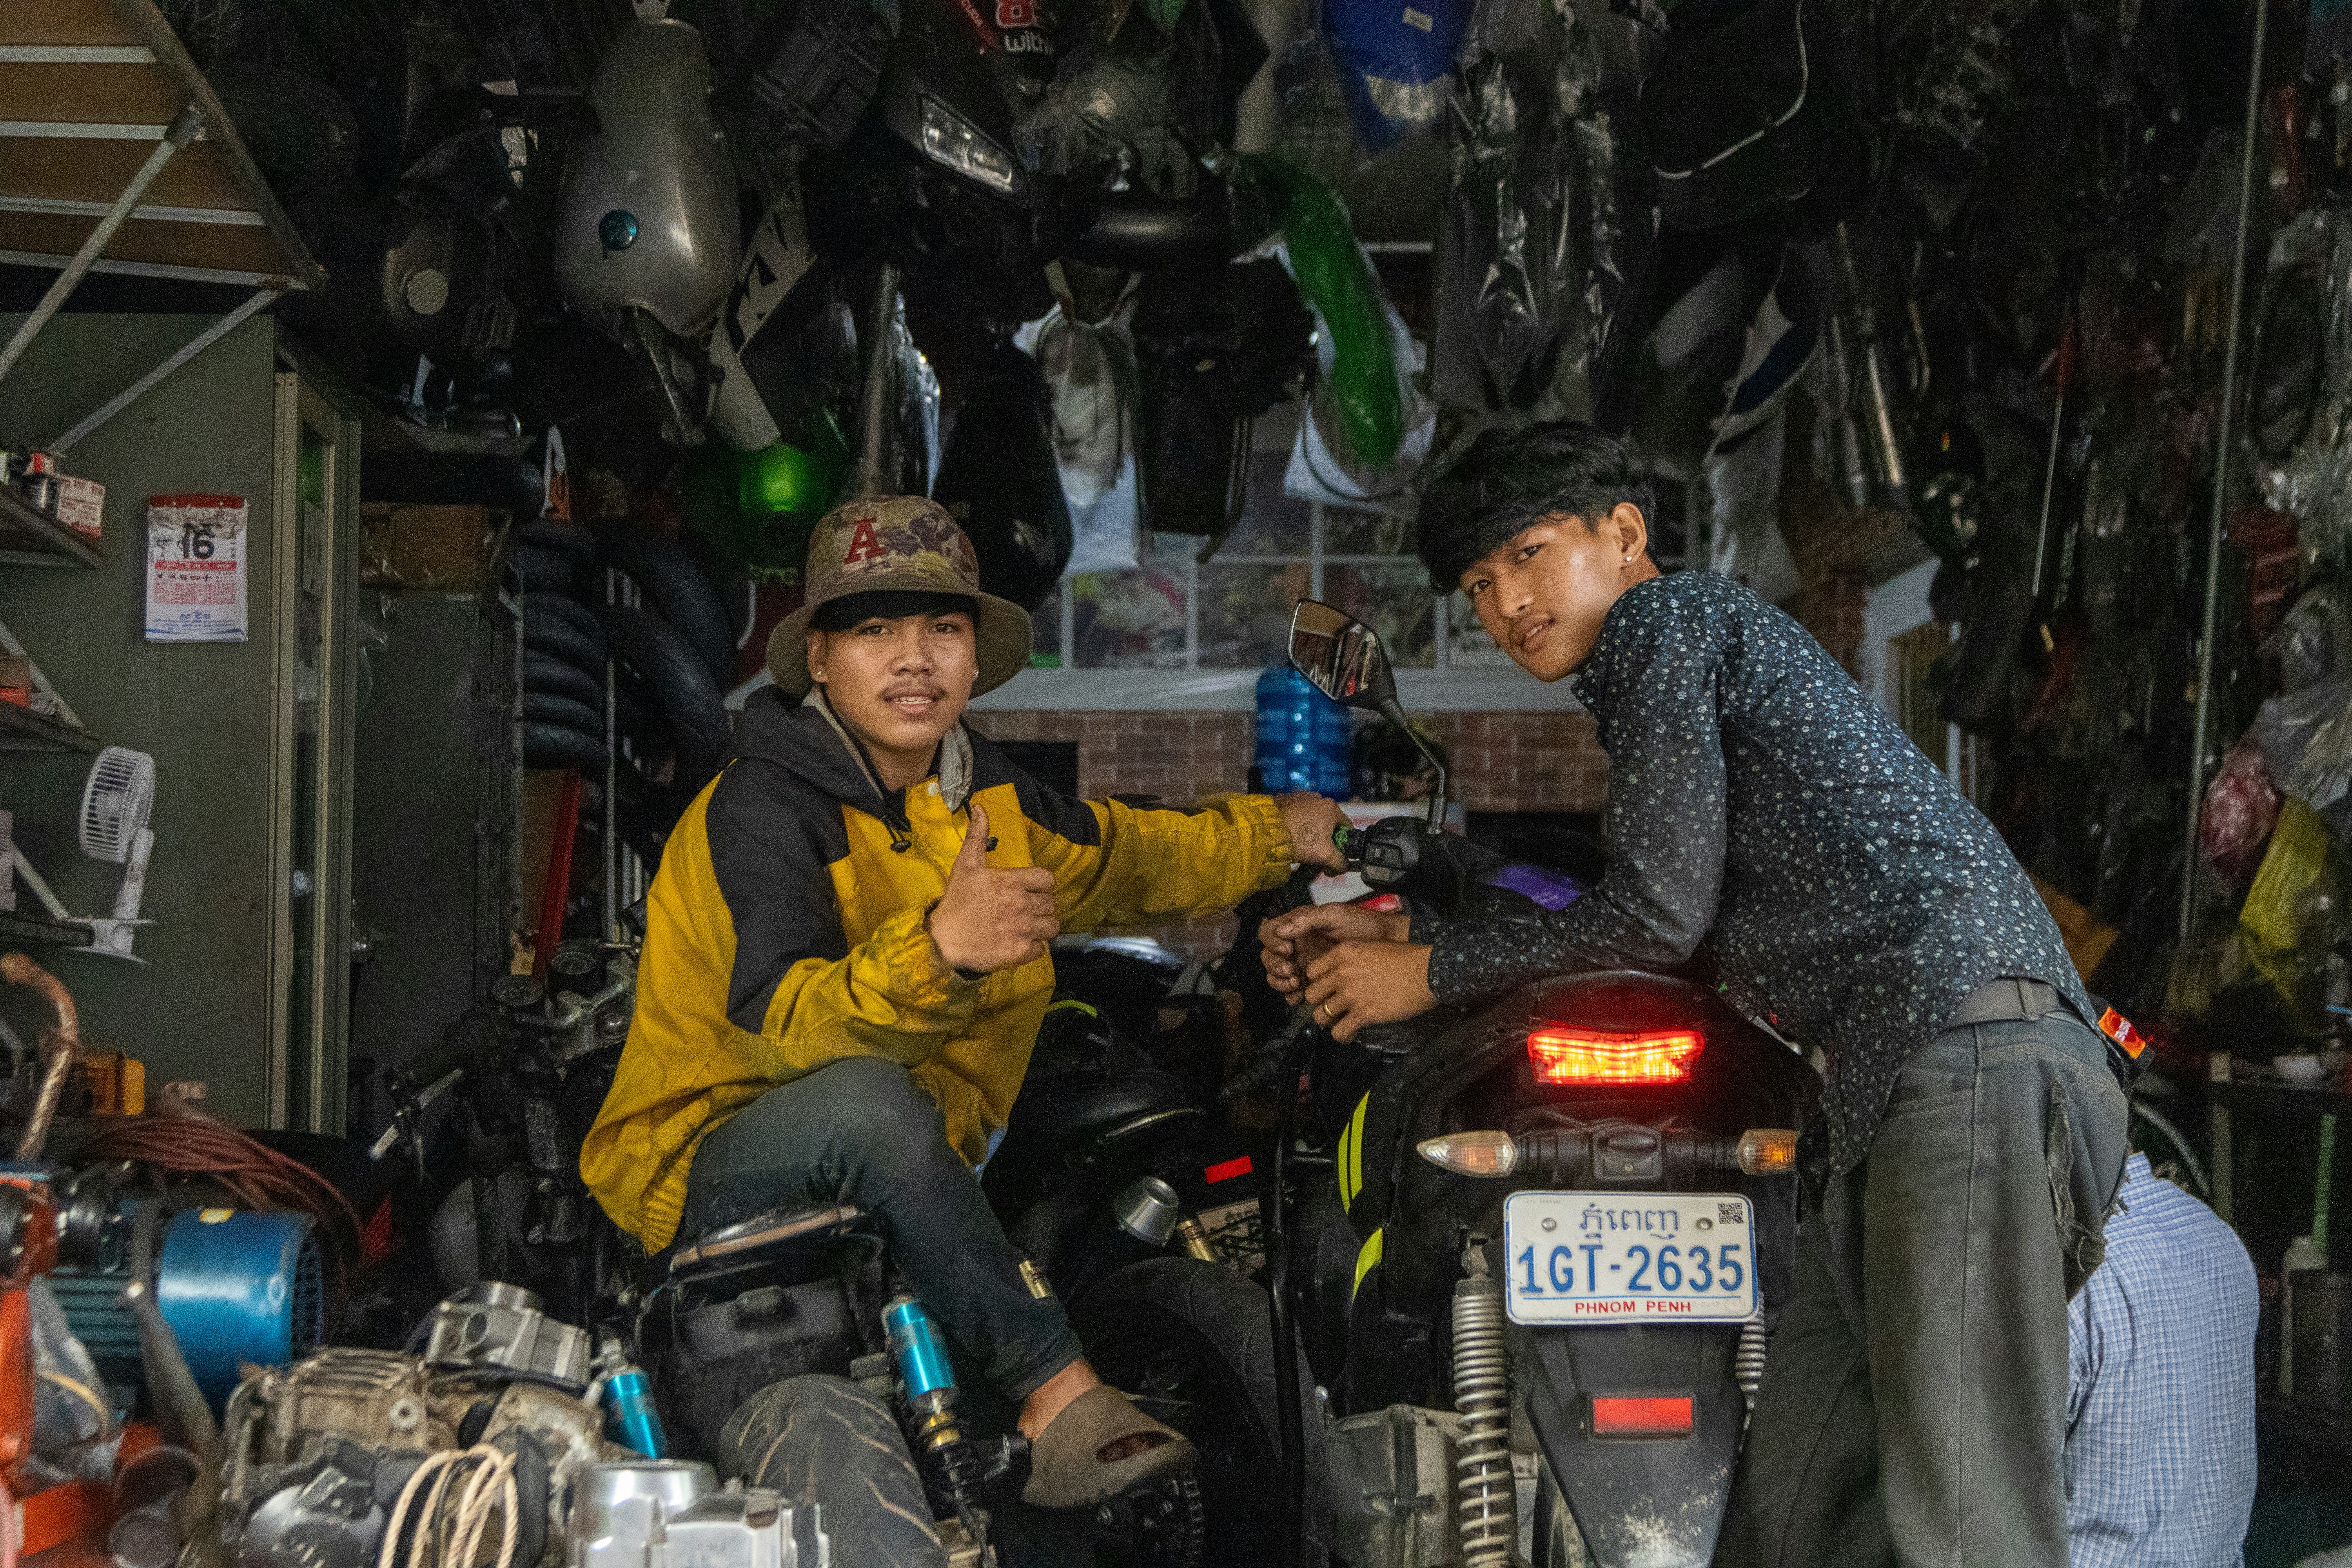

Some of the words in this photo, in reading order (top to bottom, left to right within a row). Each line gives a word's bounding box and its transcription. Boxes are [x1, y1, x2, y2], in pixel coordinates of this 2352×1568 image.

[182, 526, 215, 559] 16
[844, 517, 888, 564] A
[1519, 1244, 1743, 1294] 1GT-2635
[1575, 1301, 1635, 1314] PHNOM
[1646, 1301, 1691, 1313] PENH
